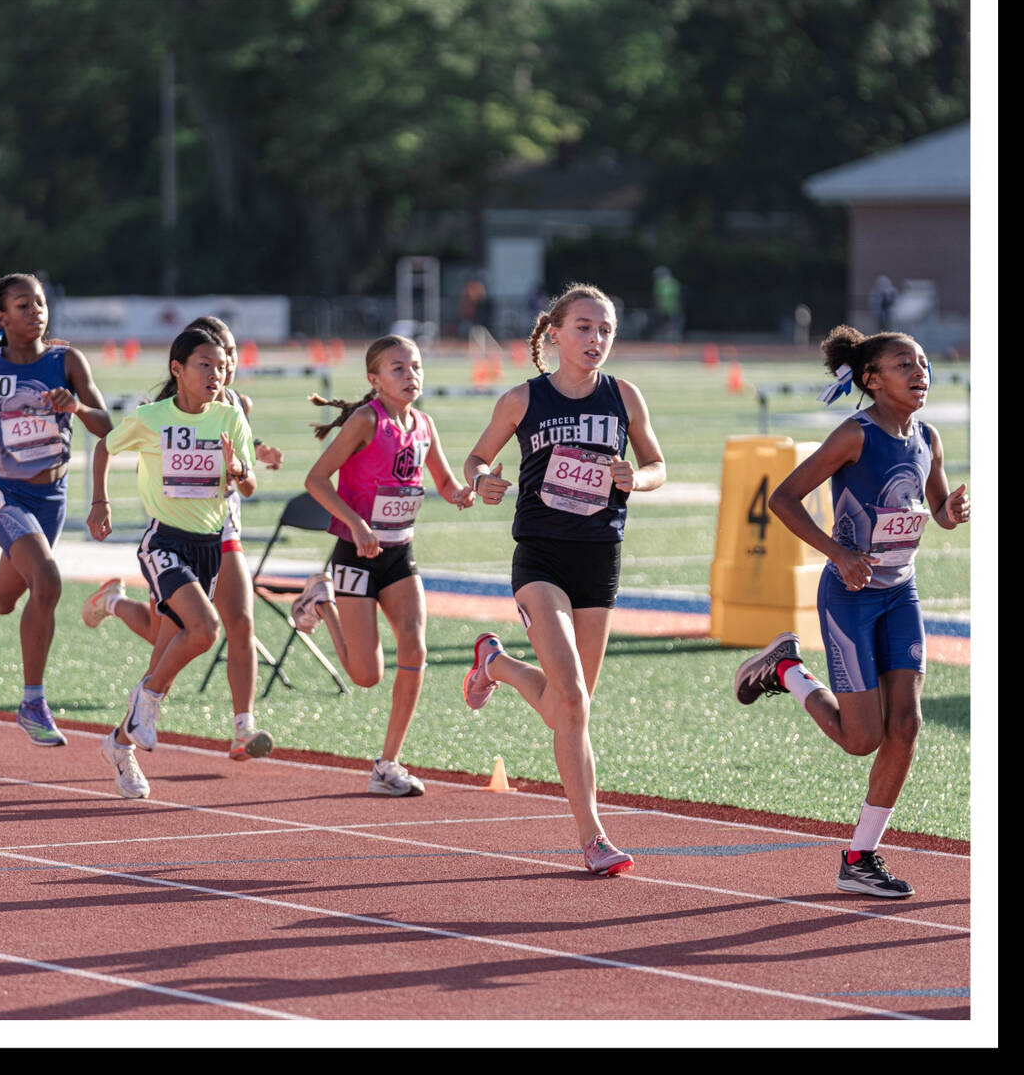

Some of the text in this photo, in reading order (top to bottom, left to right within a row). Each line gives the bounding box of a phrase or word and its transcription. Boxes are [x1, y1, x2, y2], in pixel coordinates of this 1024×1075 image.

[11, 418, 47, 438] 4317
[539, 416, 576, 430] MERCER
[582, 415, 609, 444] 11
[162, 426, 192, 450] 13
[170, 453, 215, 471] 8926
[555, 461, 604, 488] 8443
[381, 500, 417, 517] 6394
[747, 474, 771, 542] 4
[882, 515, 923, 535] 4320
[148, 548, 174, 575] 13
[337, 566, 365, 592] 17
